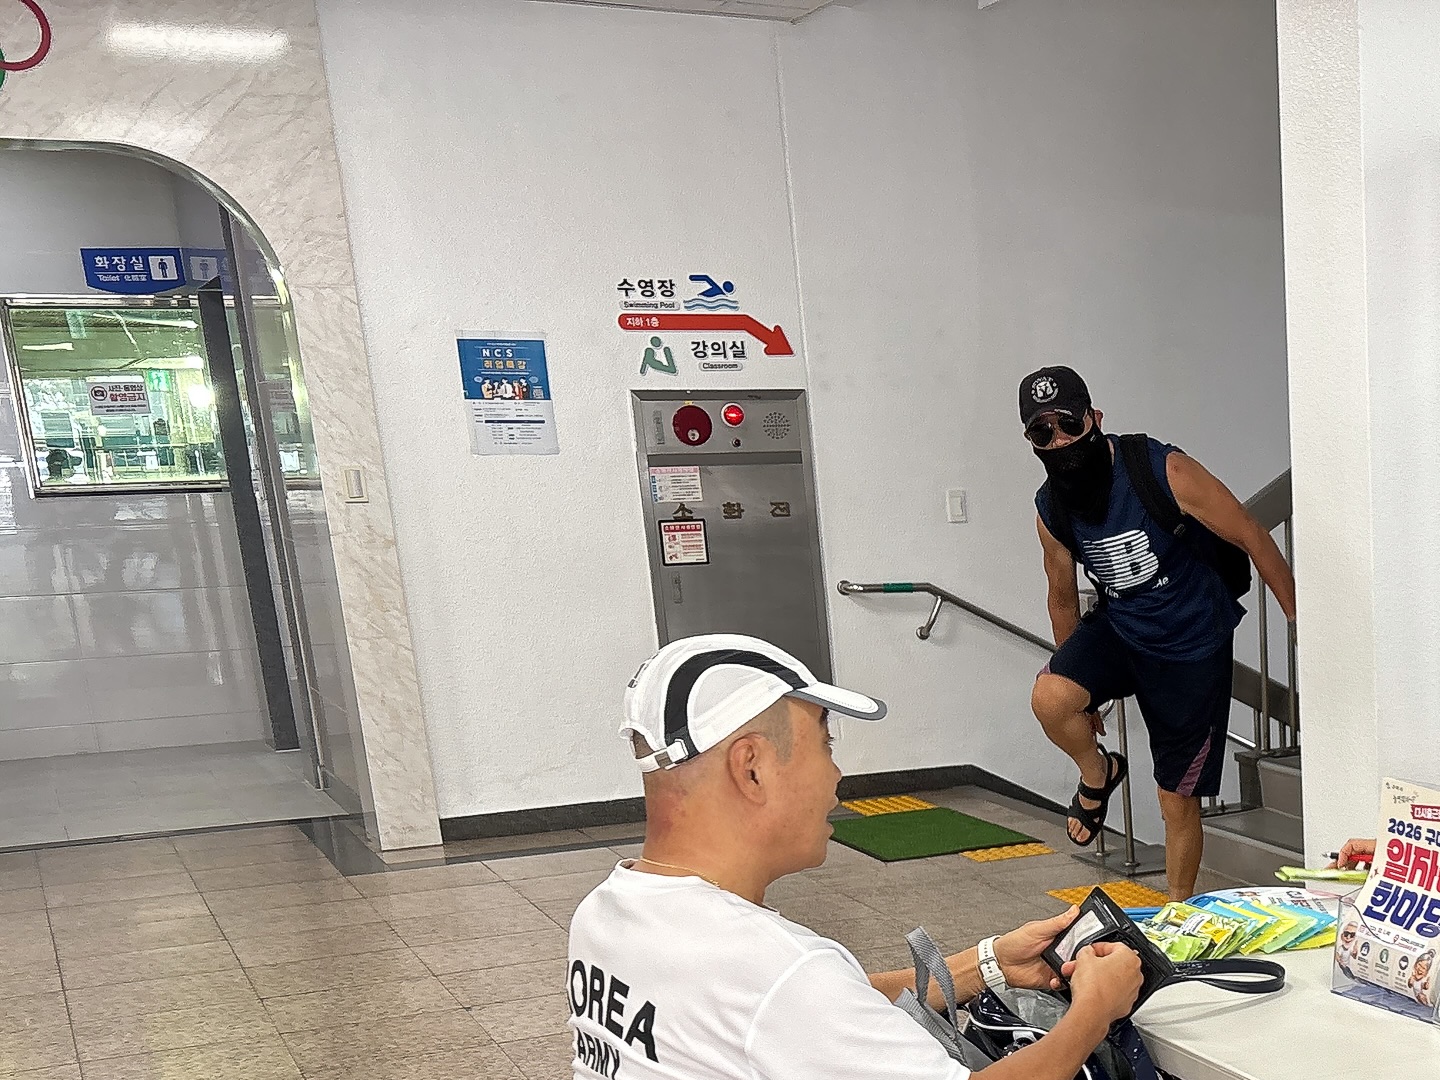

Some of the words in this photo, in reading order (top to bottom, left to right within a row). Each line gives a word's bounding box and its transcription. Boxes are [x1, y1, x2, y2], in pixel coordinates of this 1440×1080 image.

[94, 255, 145, 271] 화장실
[616, 278, 676, 298] 수영장
[623, 301, 658, 310] Swimming
[660, 301, 675, 310] Pool
[625, 316, 643, 327] 지하
[646, 316, 660, 327] 1층
[690, 340, 748, 360] 강의실
[702, 362, 739, 370] Classroom
[1387, 818, 1422, 841] 2026
[570, 959, 660, 1064] OREA
